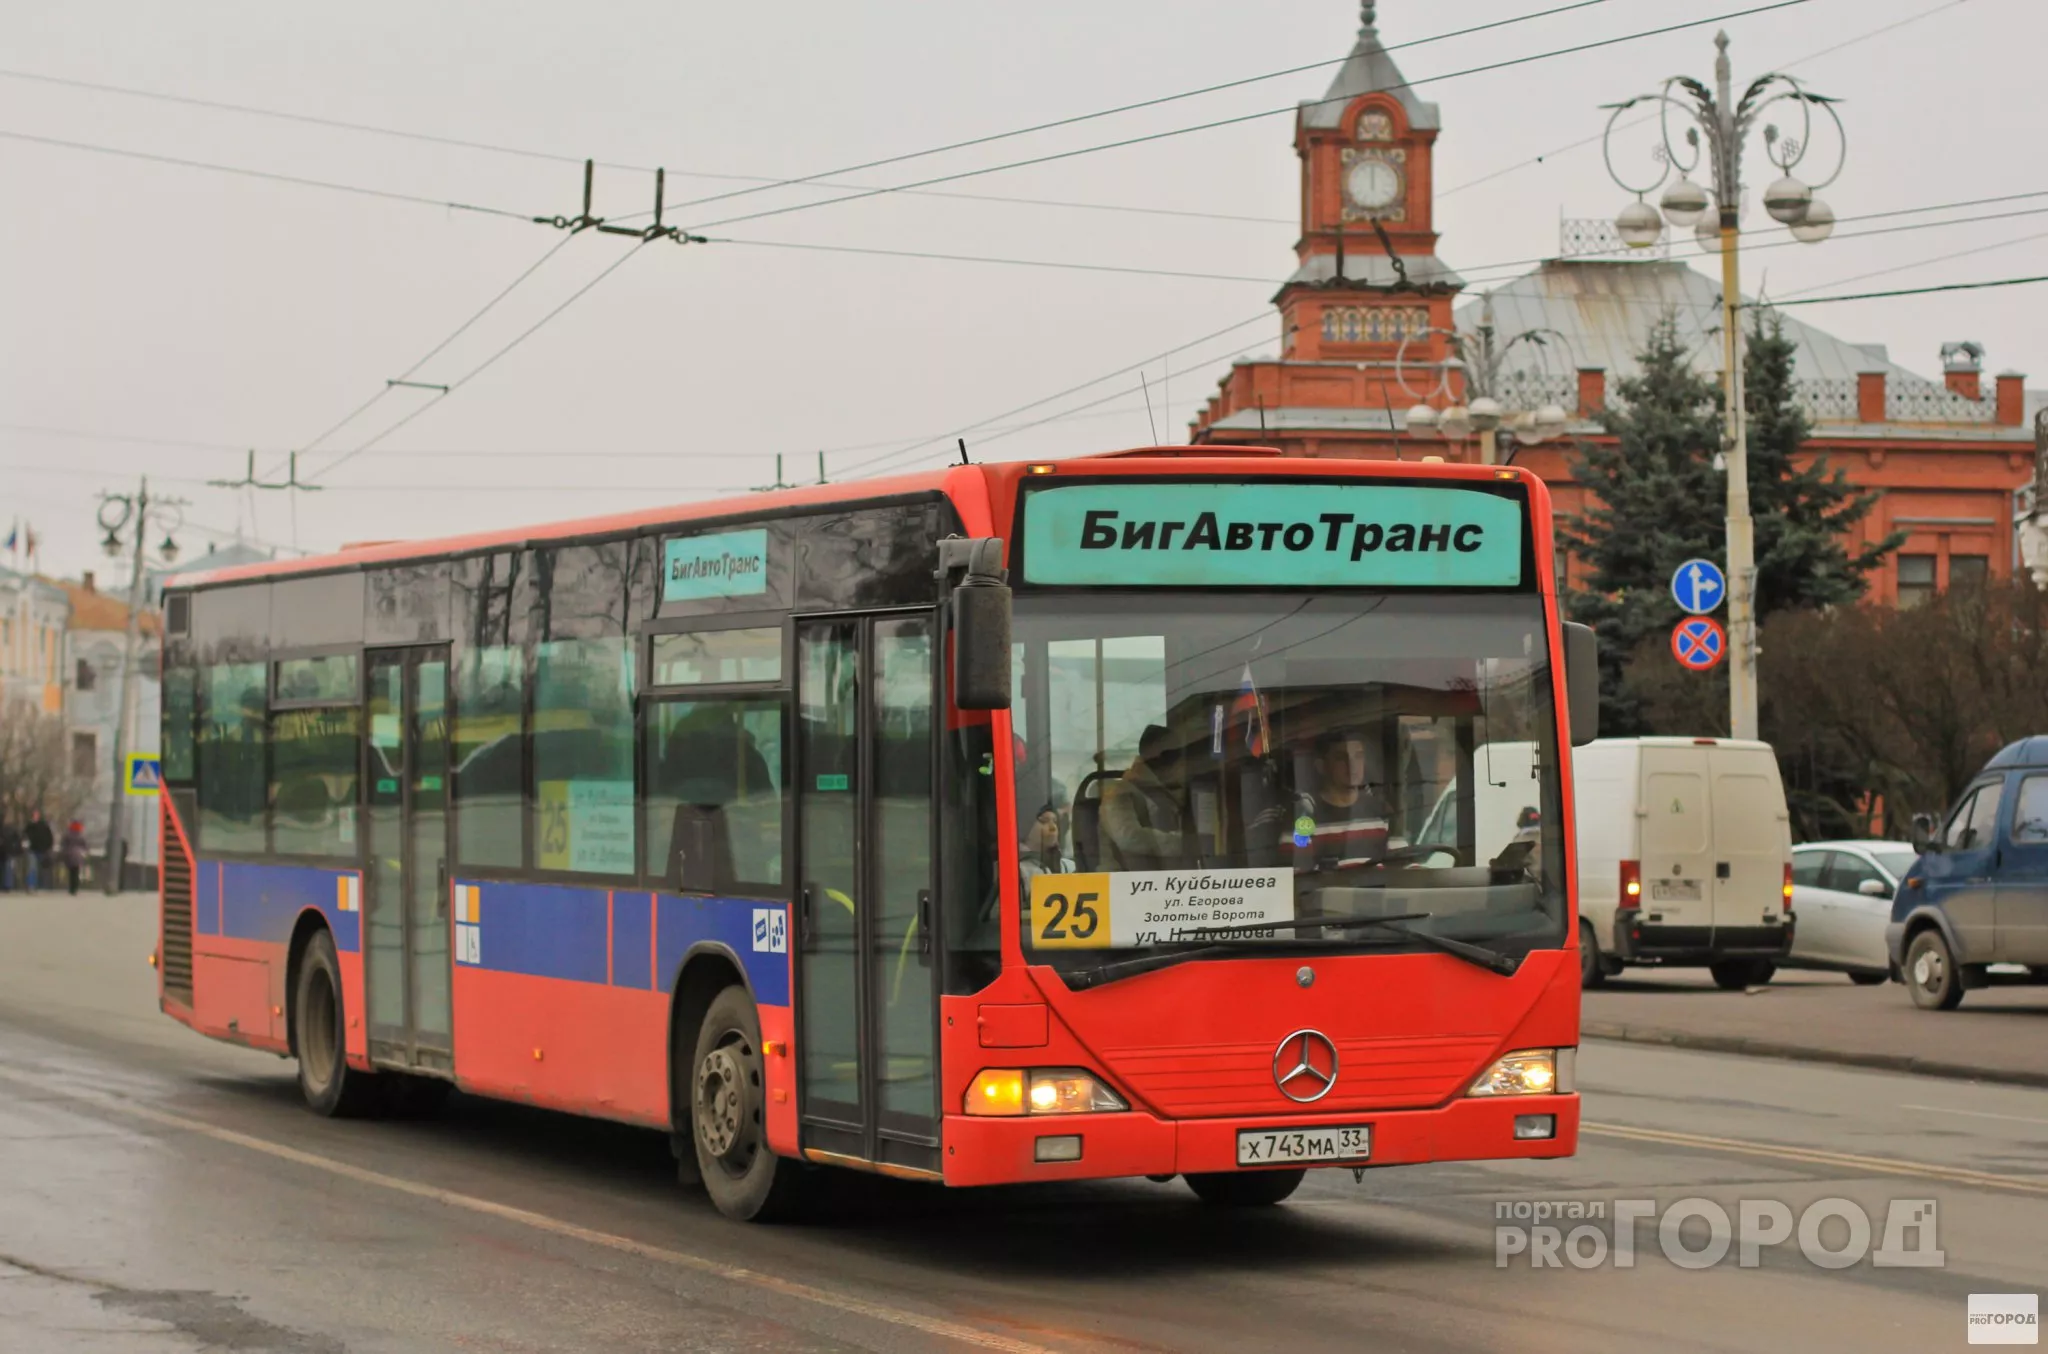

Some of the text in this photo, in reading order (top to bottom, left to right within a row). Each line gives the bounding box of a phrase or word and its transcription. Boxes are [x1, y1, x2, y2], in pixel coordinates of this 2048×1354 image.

[1080, 510, 1484, 561] БигАвтоТранс
[671, 552, 760, 581] БигАвтоТранс
[1130, 875, 1276, 895] ул. Куйбышева
[1164, 896, 1244, 909] ул. Егорова
[1041, 892, 1099, 939] 25
[1144, 910, 1265, 923] Золотые Ворота
[1135, 931, 1162, 946] ул.
